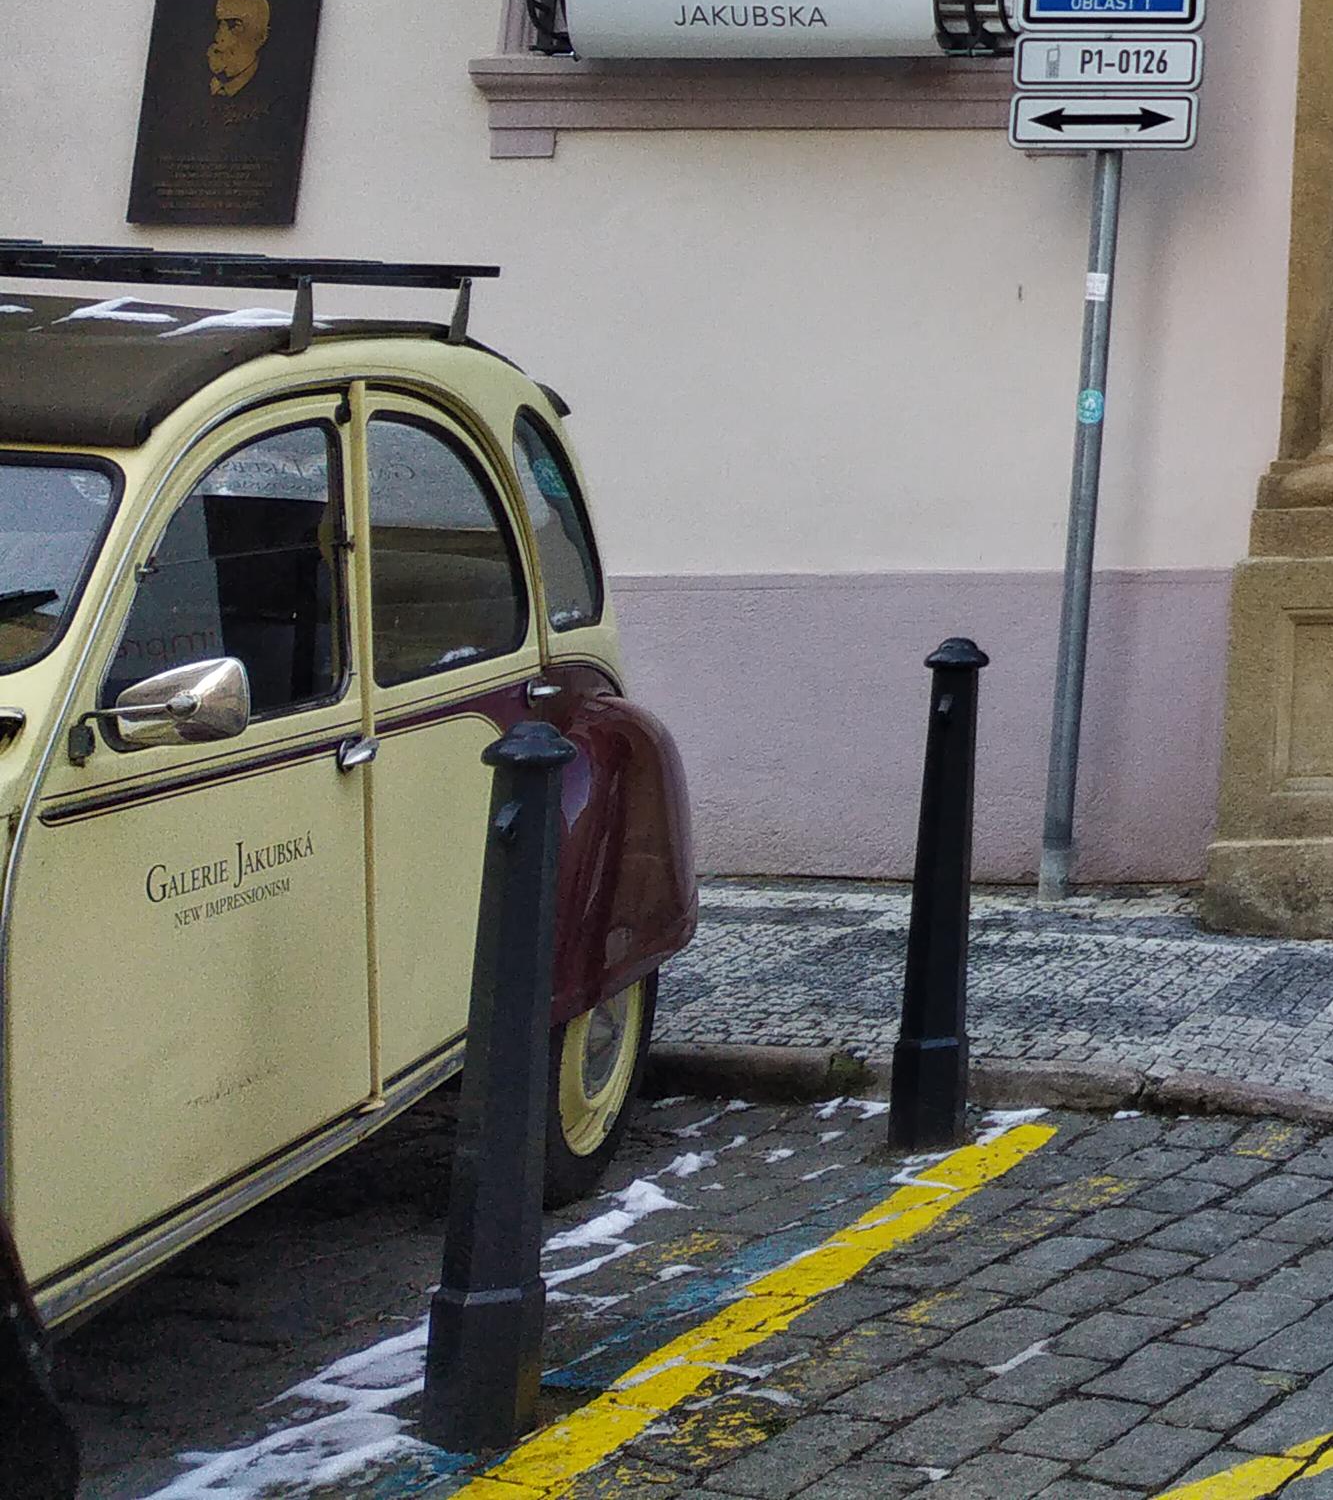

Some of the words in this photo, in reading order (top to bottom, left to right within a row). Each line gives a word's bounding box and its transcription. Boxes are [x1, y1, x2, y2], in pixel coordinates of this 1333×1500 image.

[673, 5, 828, 28] JAKUBSKA
[1080, 49, 1168, 75] P1-0126
[146, 860, 230, 903] GALERIE
[174, 904, 203, 928] NEW
[205, 878, 291, 918] IMPRESSIONISM
